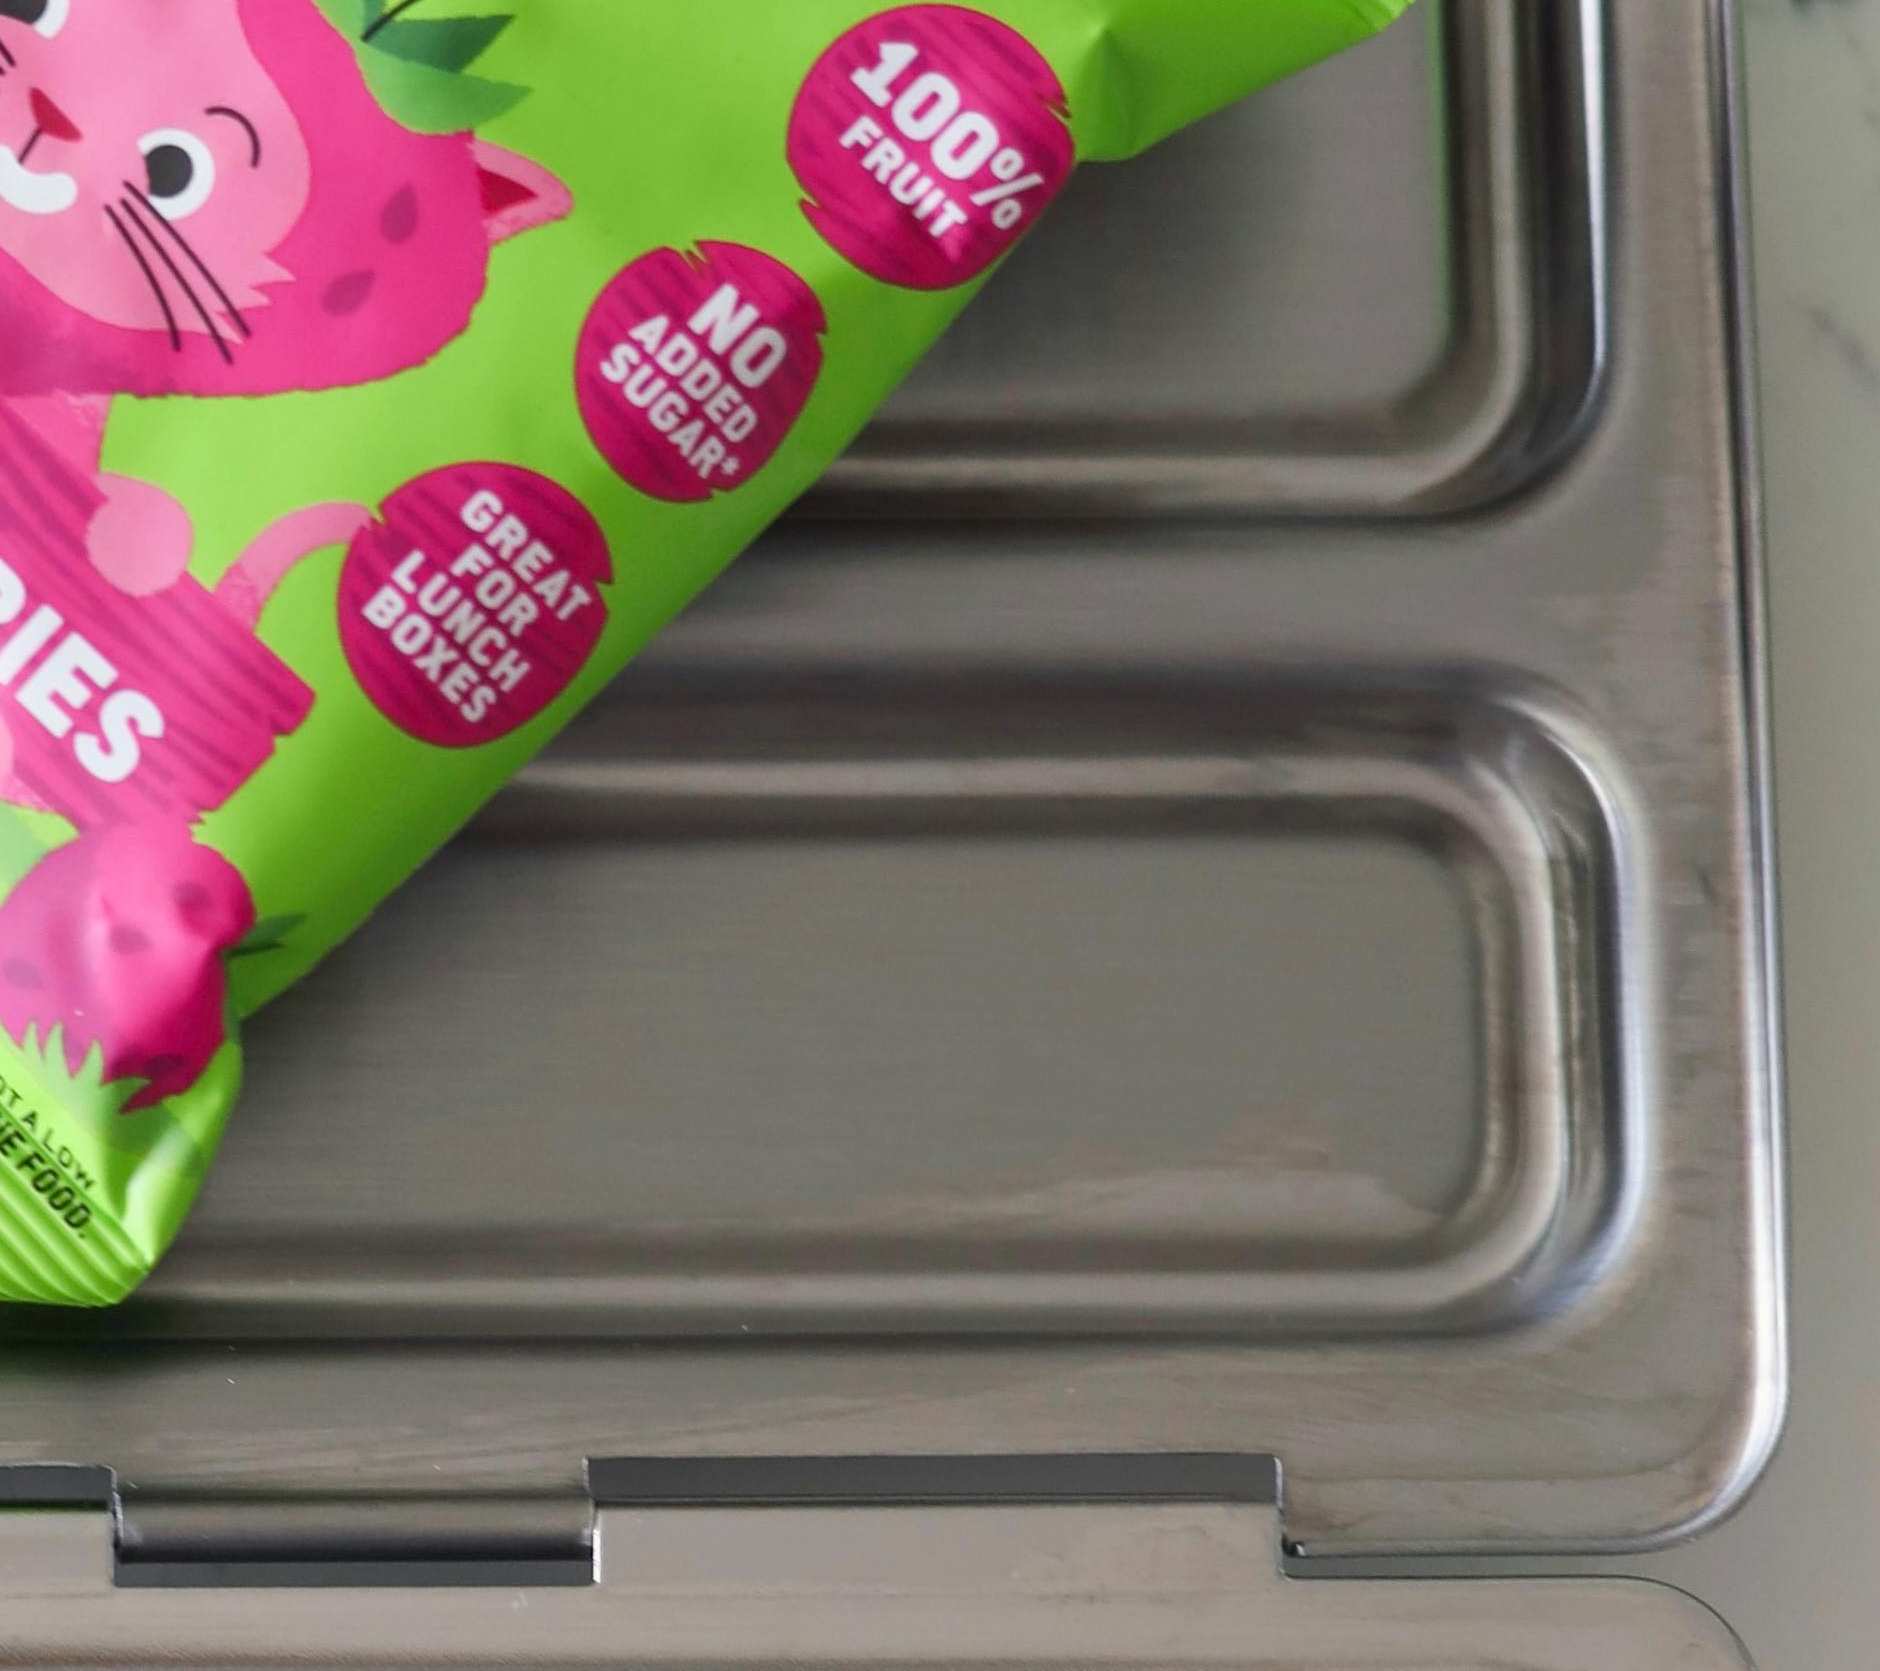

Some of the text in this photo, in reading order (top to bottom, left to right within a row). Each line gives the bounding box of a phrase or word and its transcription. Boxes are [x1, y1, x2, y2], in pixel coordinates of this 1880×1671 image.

[839, 115, 968, 238] FRUIT
[850, 41, 1044, 230] 100%
[627, 315, 758, 443] ADDED
[686, 283, 787, 388] NO
[449, 542, 539, 637] FOR
[460, 490, 592, 621] GREAT
[361, 585, 497, 723] BOXES
[391, 549, 531, 692] LUNCH
[21, 1110, 38, 1130] A
[42, 1129, 95, 1190] LOW
